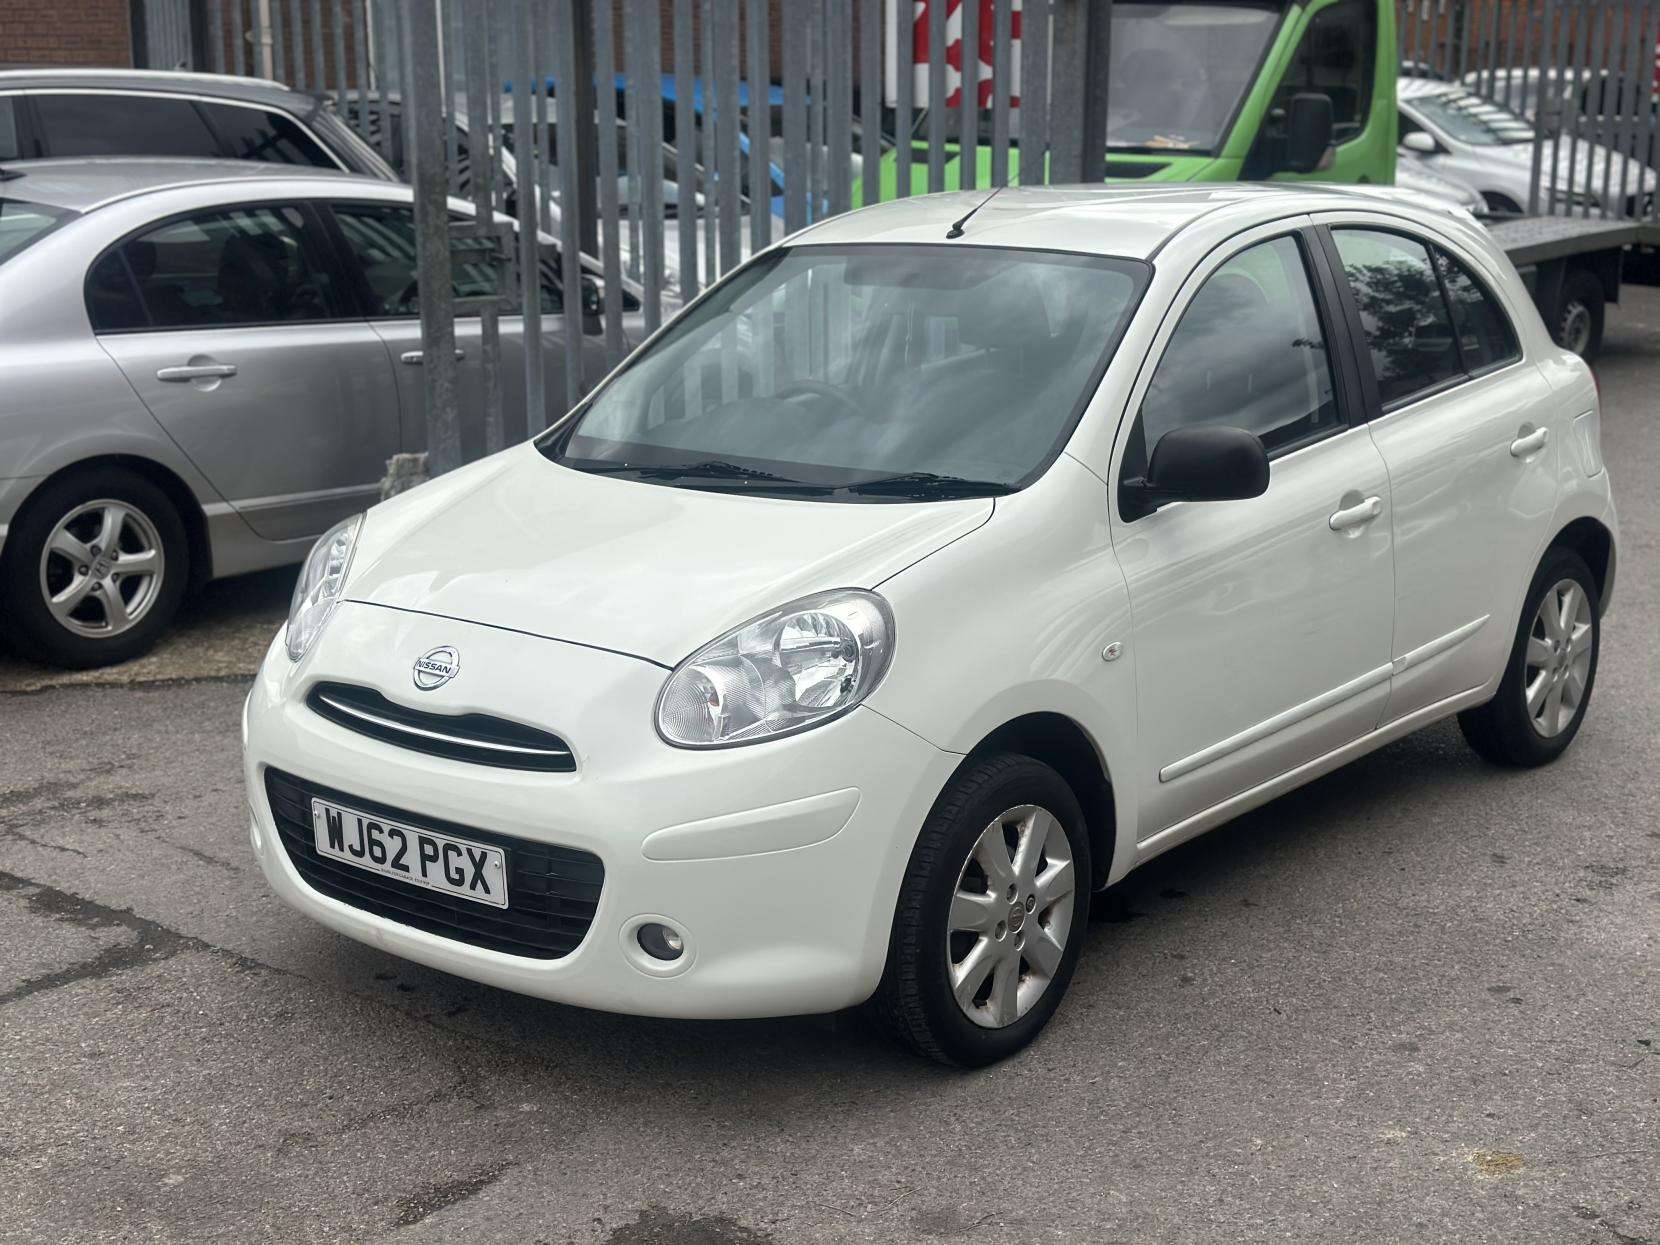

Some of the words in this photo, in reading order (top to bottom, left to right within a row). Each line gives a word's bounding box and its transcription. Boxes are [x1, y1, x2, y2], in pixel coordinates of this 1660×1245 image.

[416, 660, 452, 674] NISSAN
[325, 807, 409, 873] WJ62
[418, 835, 491, 894] PGX
